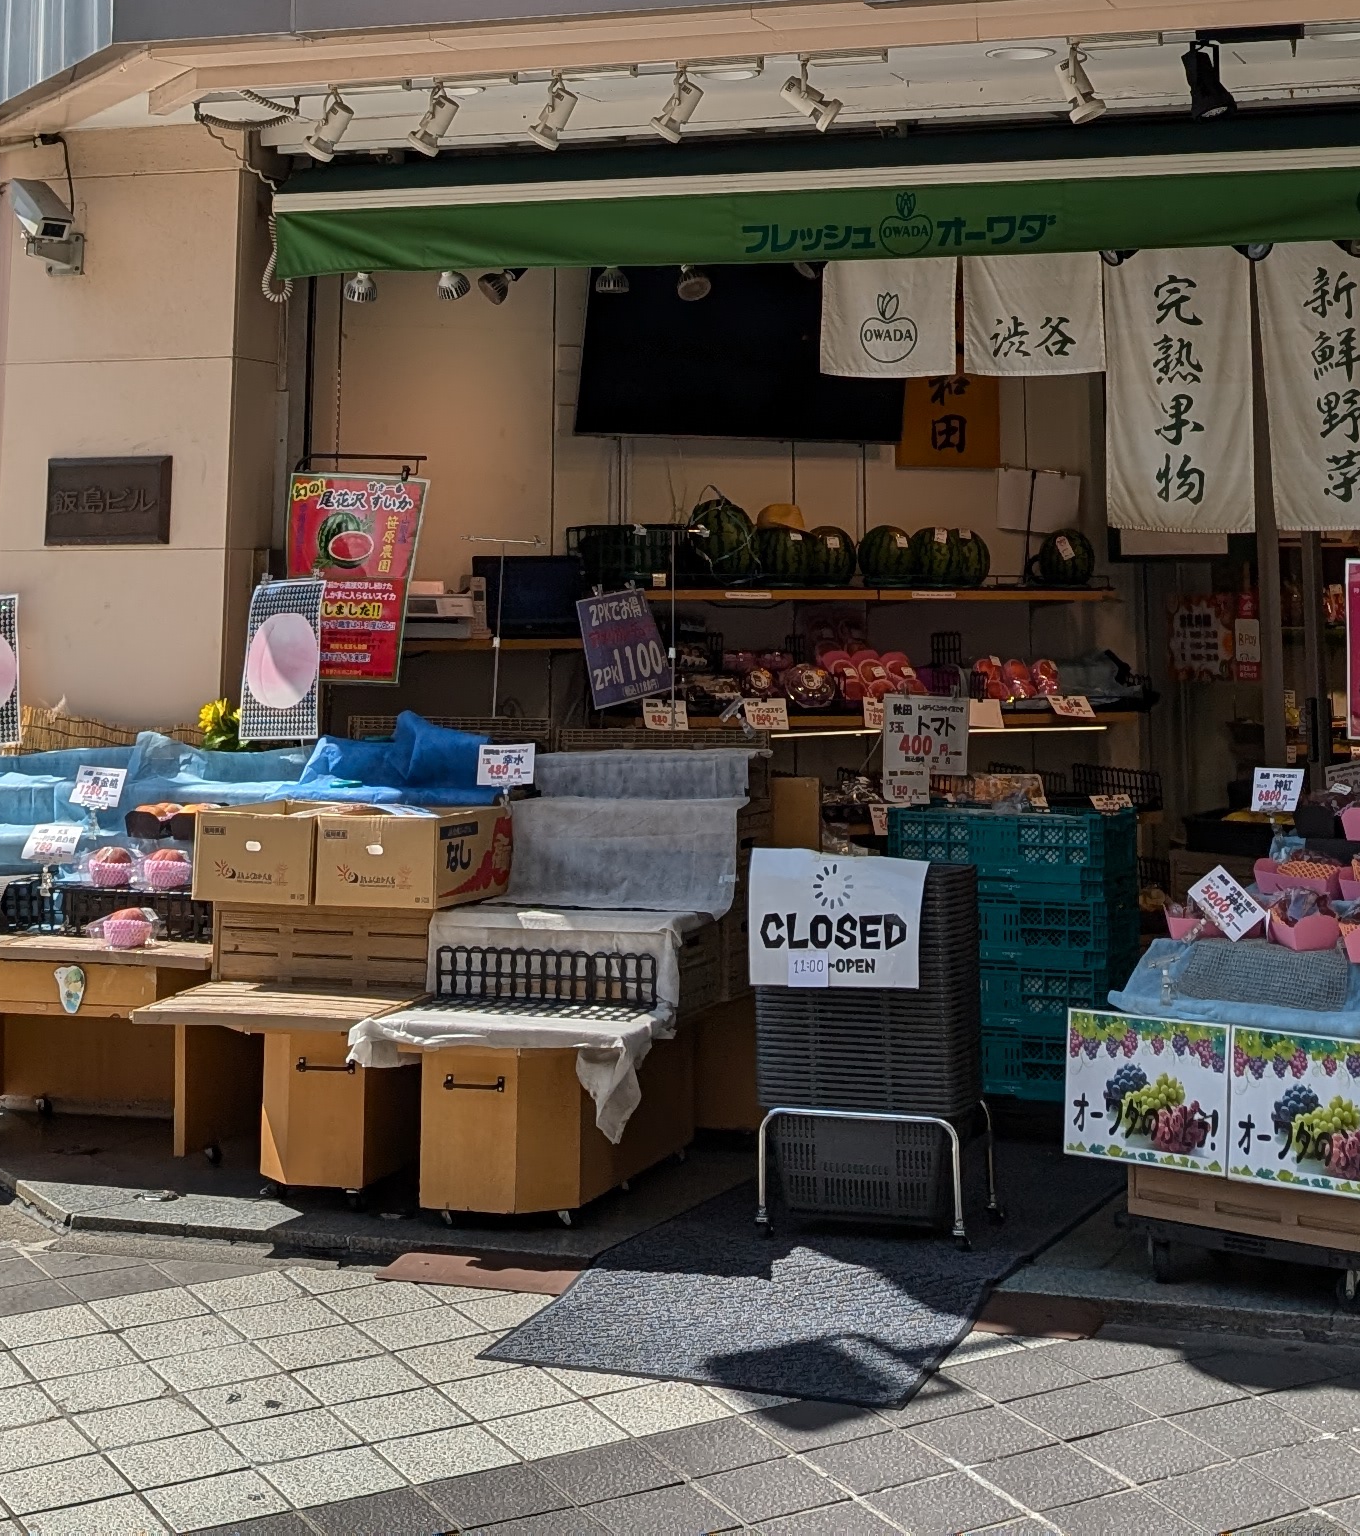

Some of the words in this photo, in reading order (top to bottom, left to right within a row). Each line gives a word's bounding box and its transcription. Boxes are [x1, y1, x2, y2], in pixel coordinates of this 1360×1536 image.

[741, 223, 876, 254] フレッシュ
[883, 224, 931, 239] OWADA
[936, 213, 1057, 245] オーワダ
[863, 328, 914, 344] OWADA
[989, 315, 1077, 358] 渋谷
[1152, 274, 1206, 506] 完熟果物
[51, 485, 156, 514] 飯島ビル
[317, 489, 368, 509] 尾花沢
[370, 493, 414, 512] すいか
[378, 515, 401, 574] 笹原農園
[592, 666, 621, 691] 2PK
[613, 639, 662, 685] 1100
[892, 703, 914, 716] 秋田
[916, 714, 957, 738] トマト
[898, 734, 934, 757] 400
[487, 764, 510, 776] 480
[79, 784, 103, 797] 1280
[90, 776, 119, 789] 黄金桃
[1257, 789, 1281, 802] 6800
[446, 839, 472, 873] なし
[1200, 883, 1231, 914] 5000
[759, 912, 908, 952] CLOSED
[792, 957, 825, 975] 11:00
